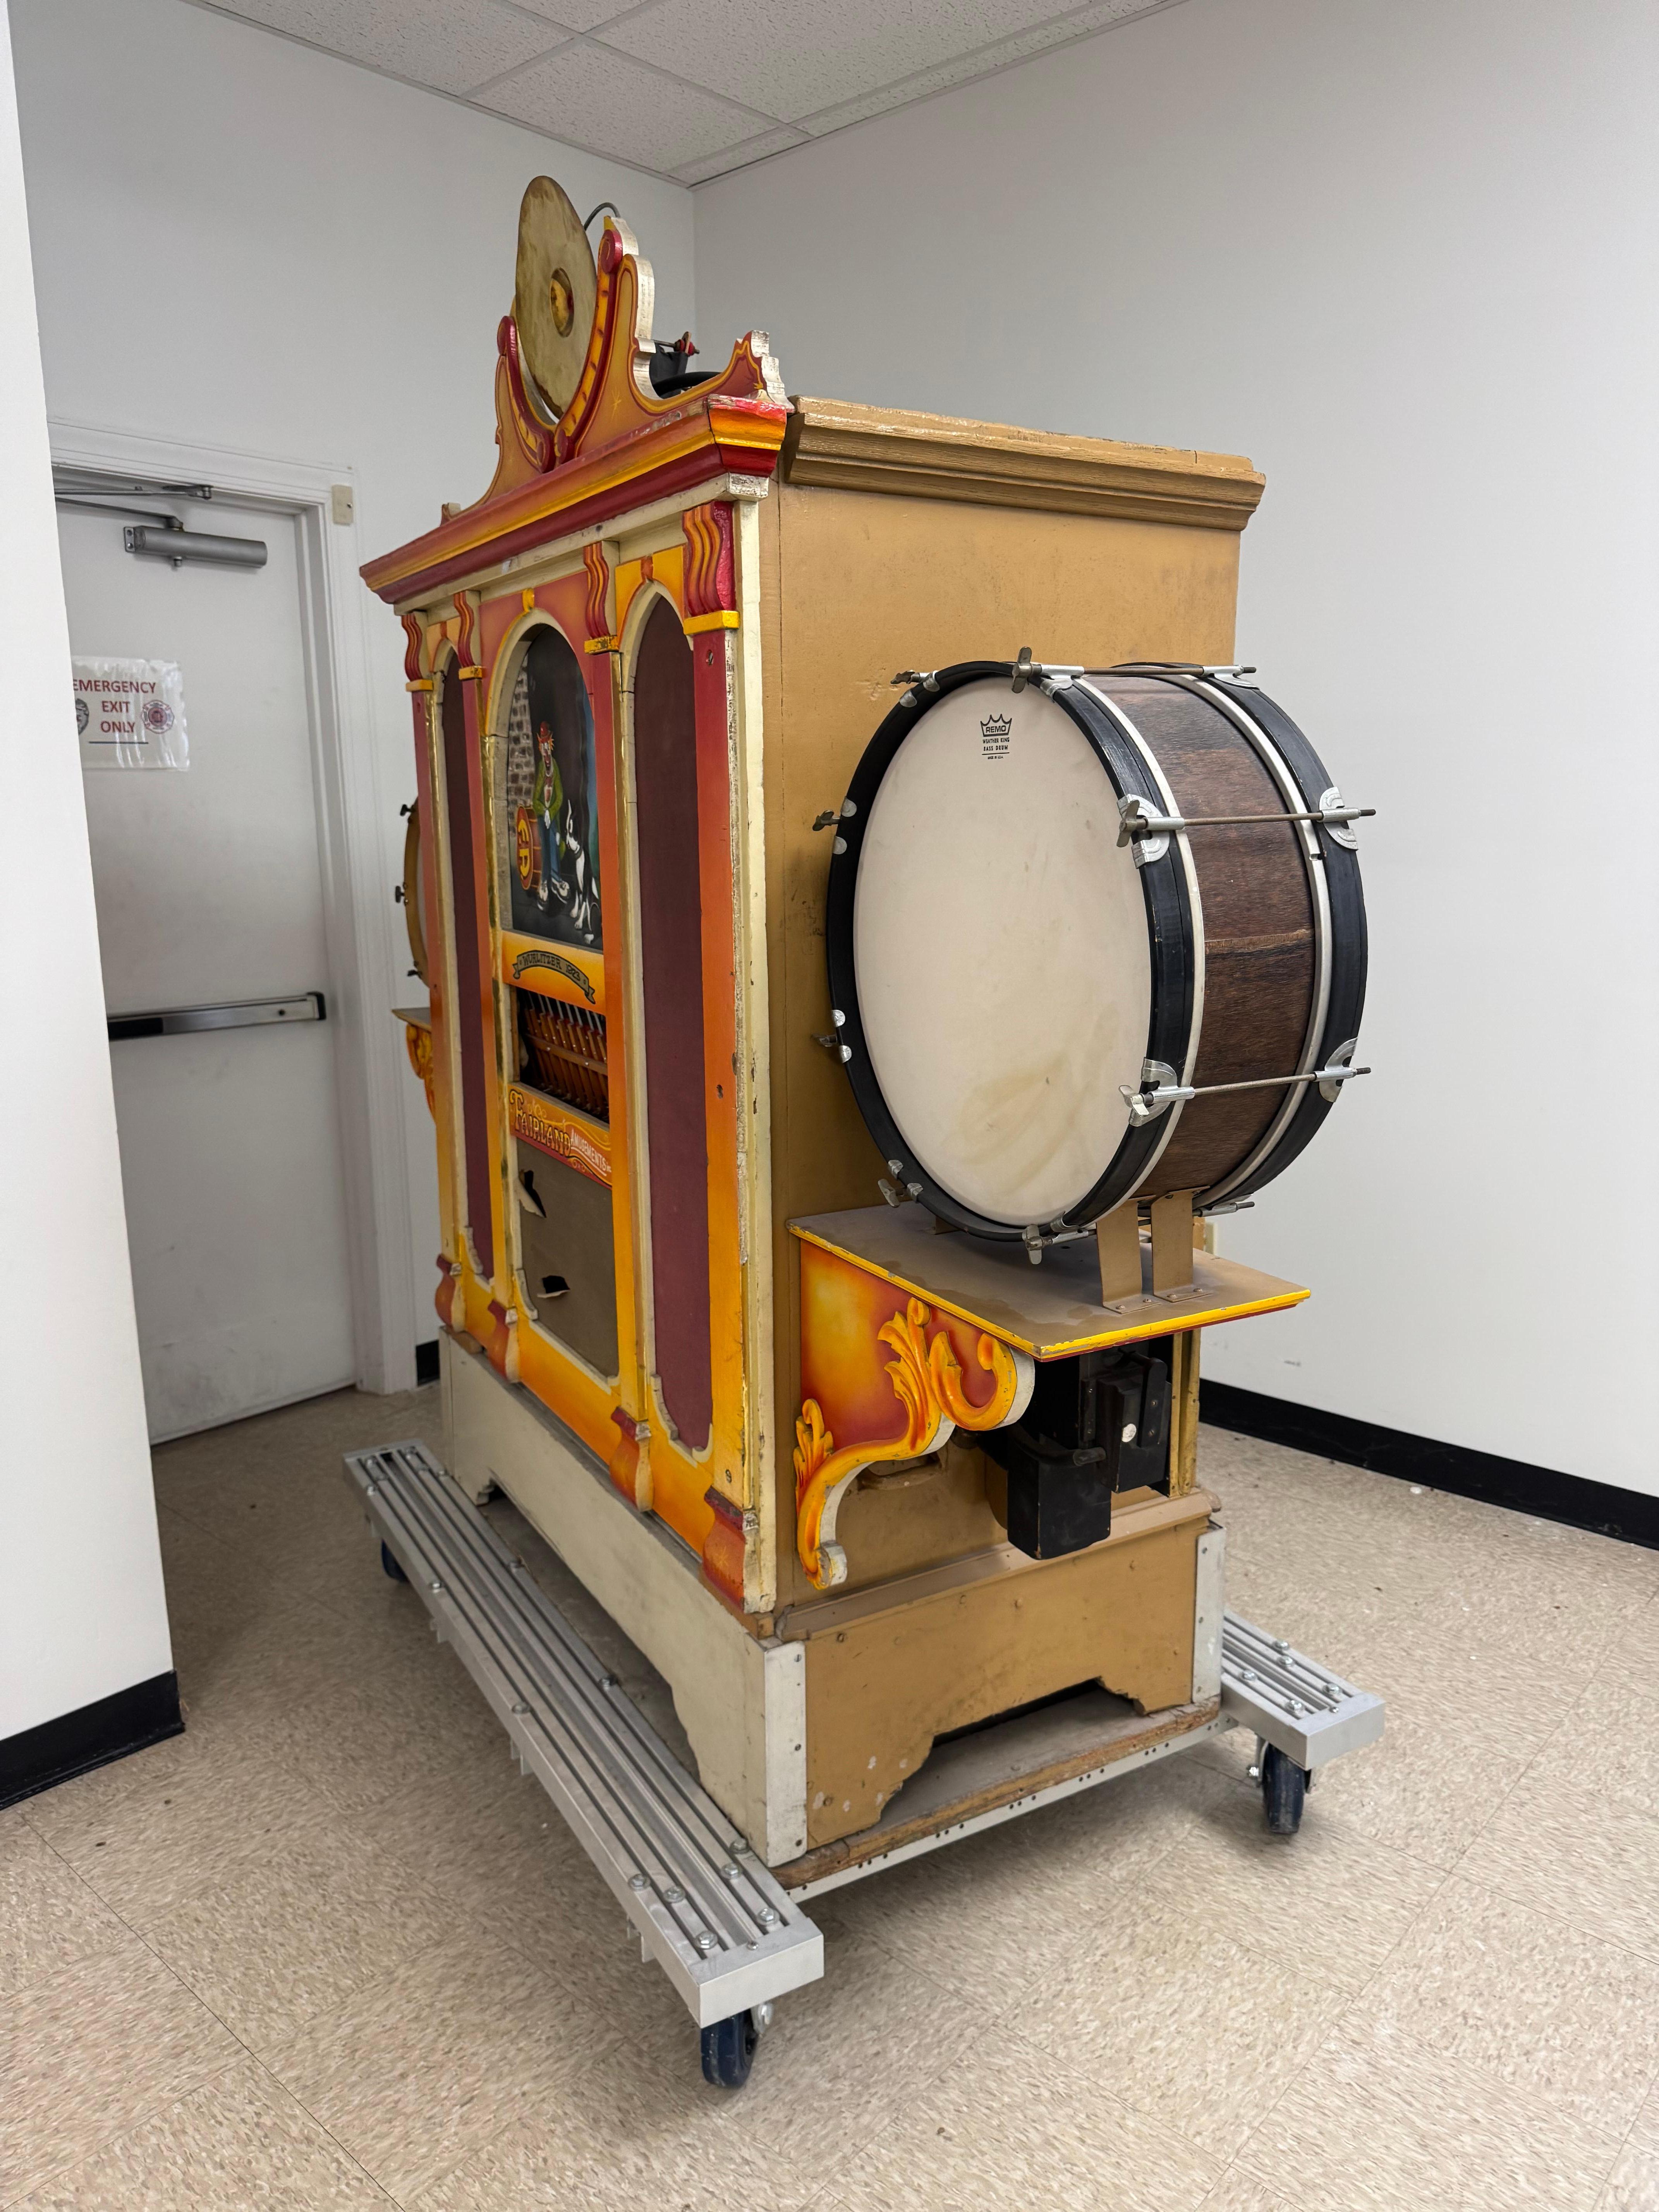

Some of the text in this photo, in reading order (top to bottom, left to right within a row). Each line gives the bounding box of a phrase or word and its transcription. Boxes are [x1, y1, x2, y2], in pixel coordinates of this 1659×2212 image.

[73, 679, 156, 693] EMERGENCY
[102, 700, 129, 713] EXIT
[101, 721, 134, 733] ONLY
[522, 953, 562, 970] WURLITZER
[509, 1089, 571, 1158] FAIRLAND
[571, 1128, 606, 1171] AMUSEMENTS
